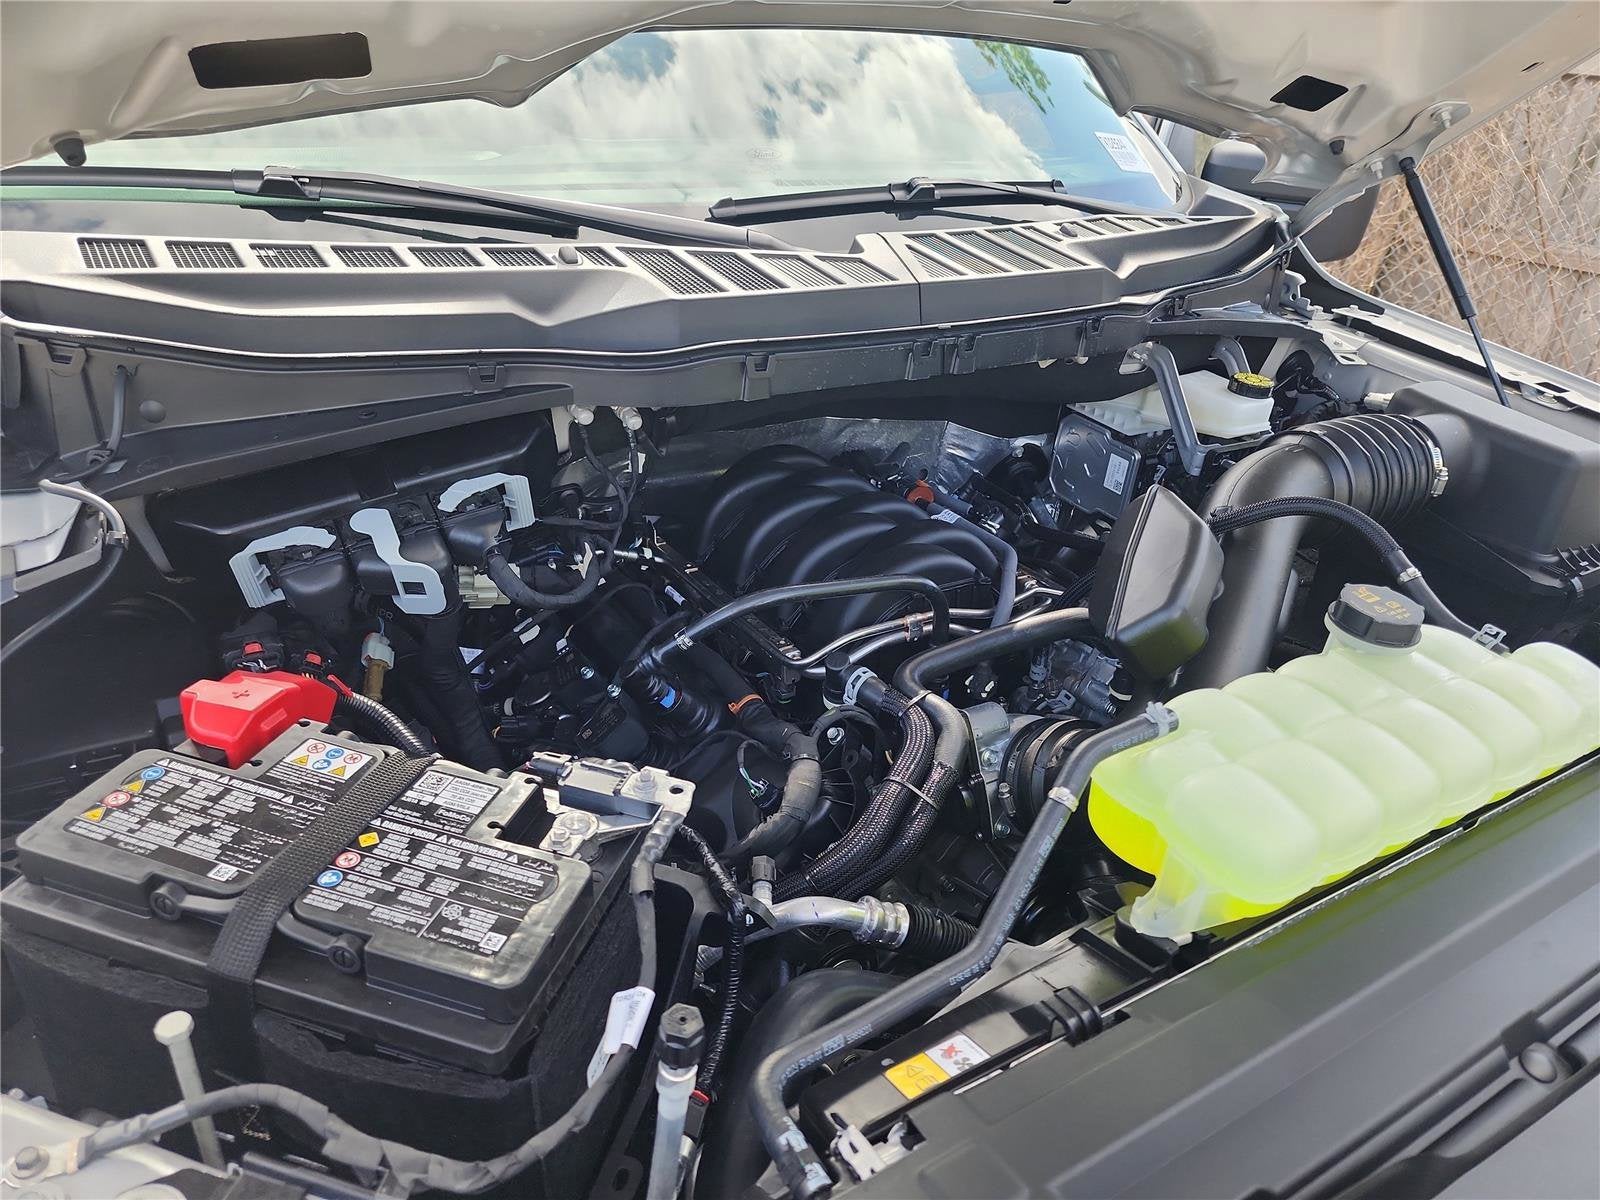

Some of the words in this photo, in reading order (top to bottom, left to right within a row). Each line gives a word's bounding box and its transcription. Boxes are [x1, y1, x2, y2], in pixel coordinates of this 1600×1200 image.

[439, 808, 471, 822] FoMoCo
[381, 820, 438, 841] DANGER/POISON
[447, 838, 508, 860] PELIGRO/VENENO
